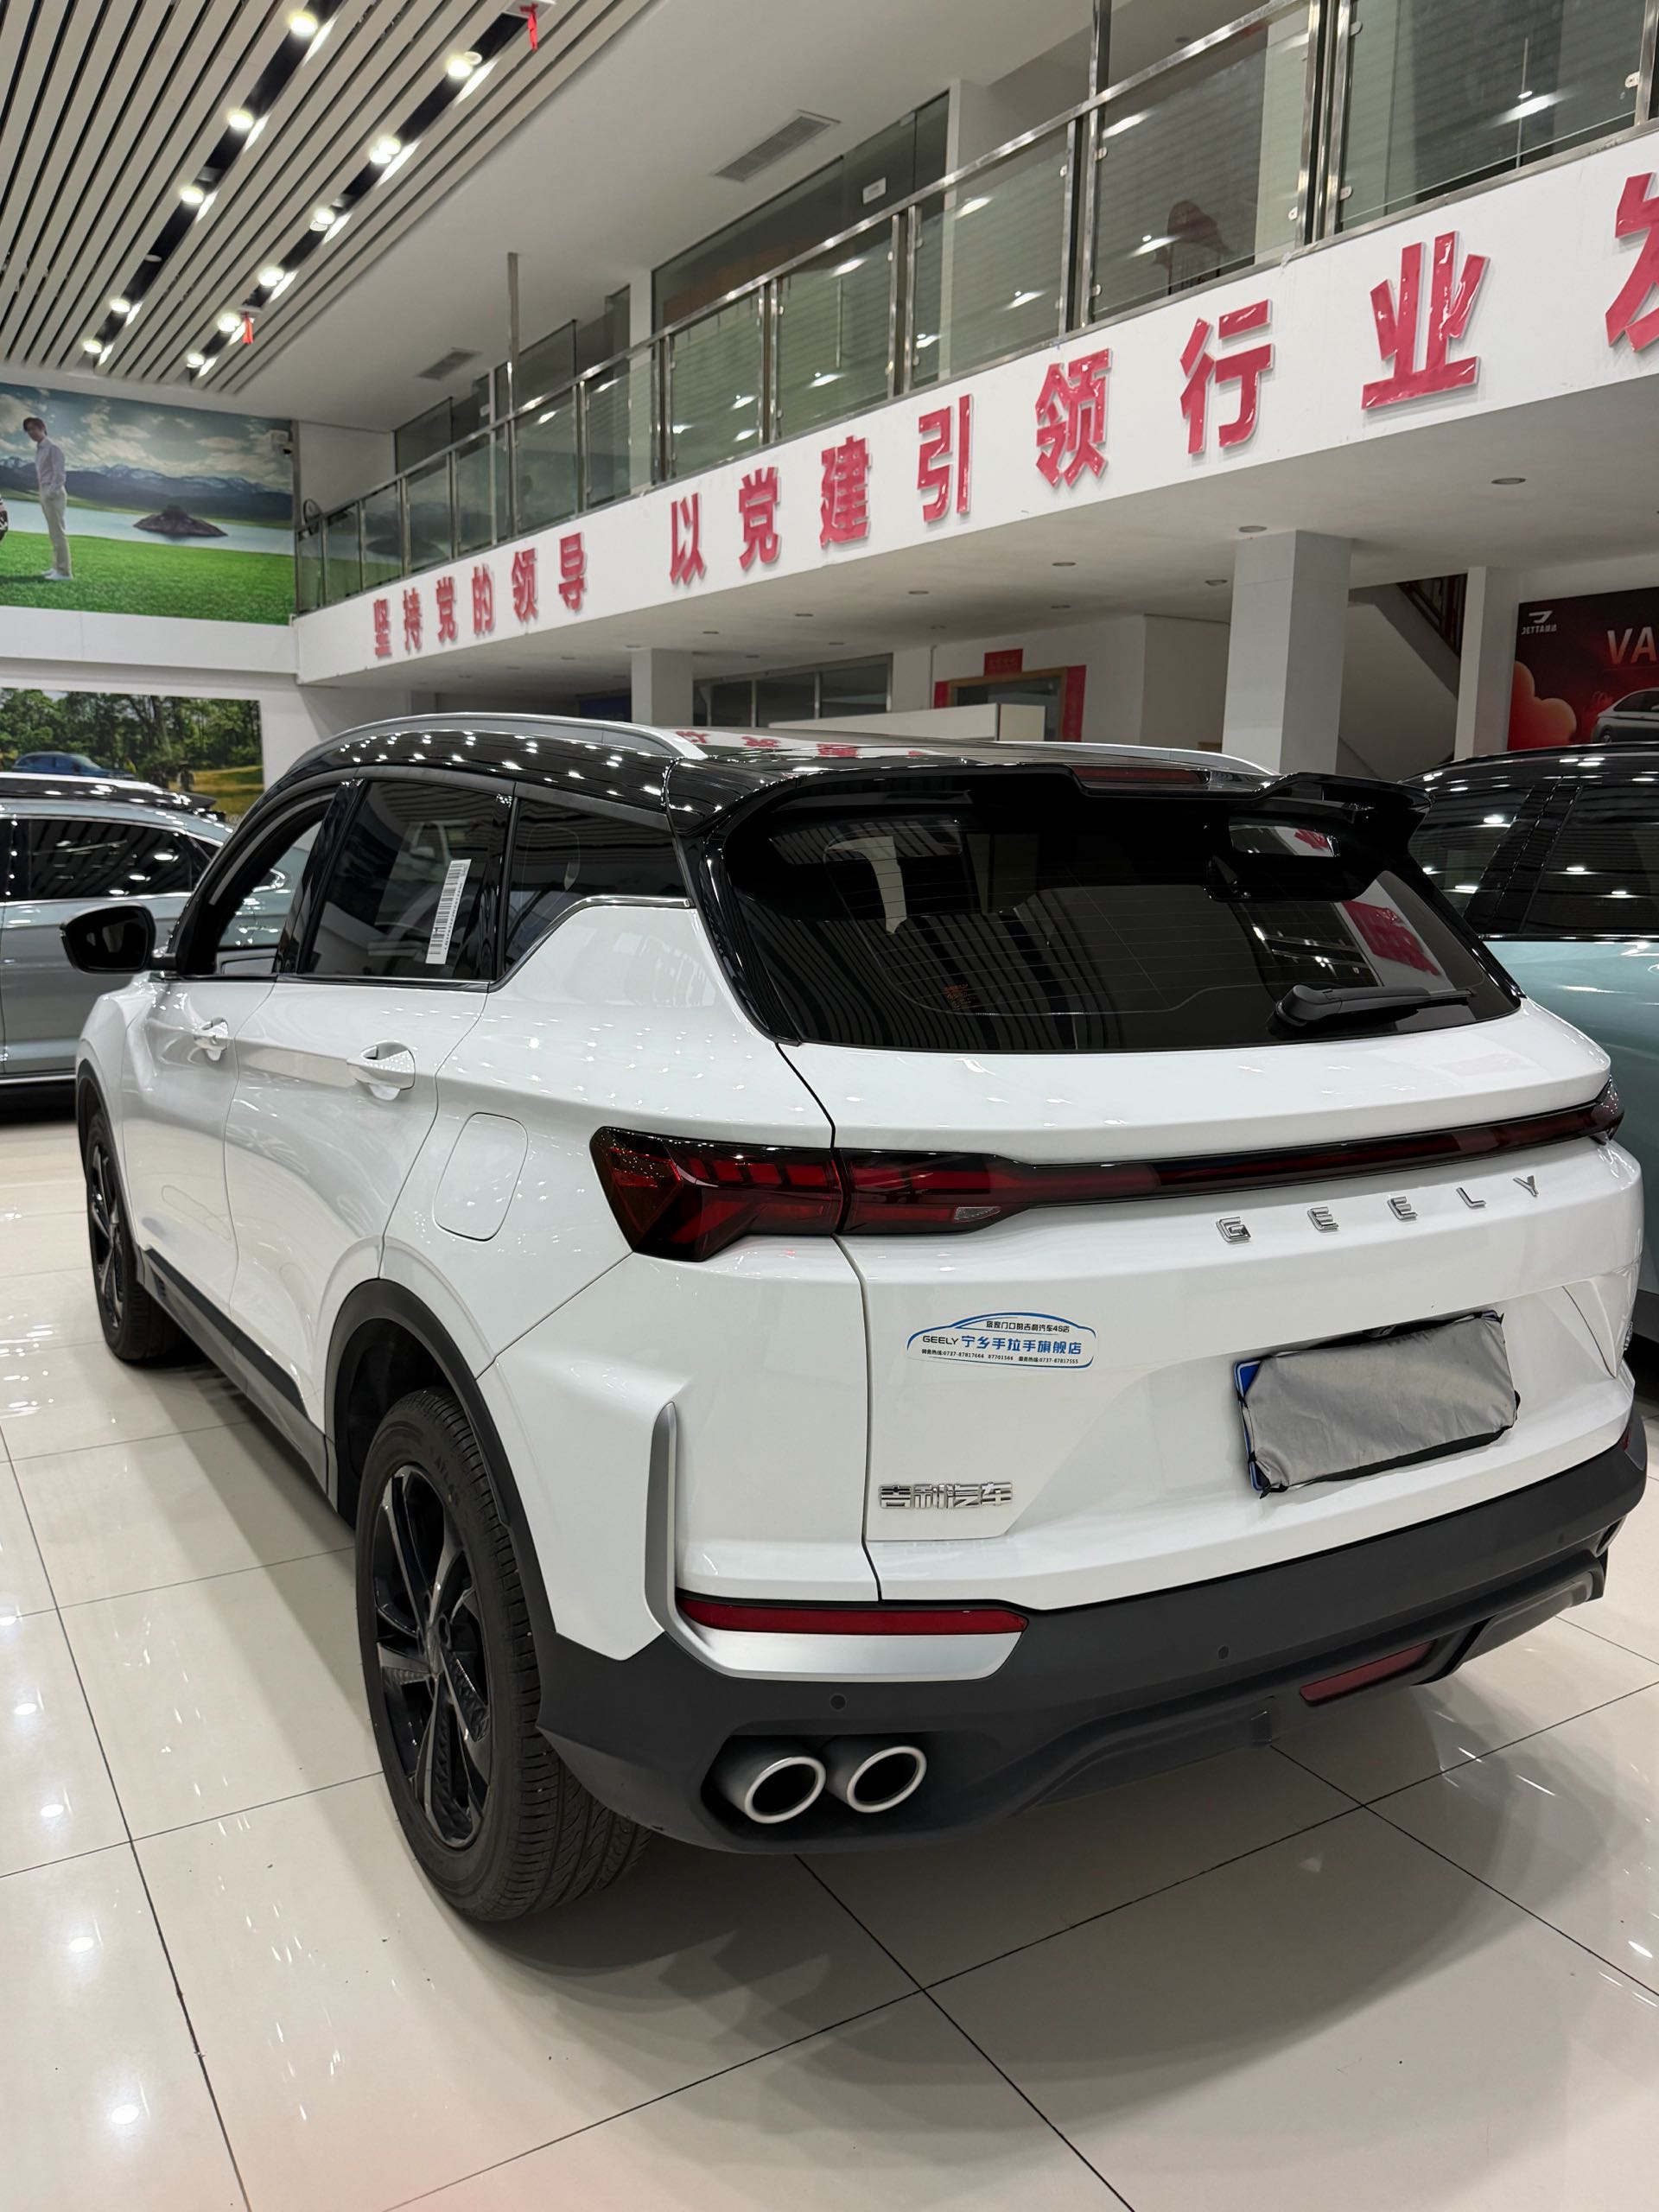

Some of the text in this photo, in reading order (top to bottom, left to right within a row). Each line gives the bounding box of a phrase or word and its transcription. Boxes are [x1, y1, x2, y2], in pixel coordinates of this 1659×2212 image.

[372, 531, 588, 657] 坚持党的领导
[1216, 1174, 1540, 1244] GEELY
[922, 1335, 1082, 1354] GEELY 宁乡手拉手旗舰店
[880, 1481, 1013, 1510] 吉利汽车
